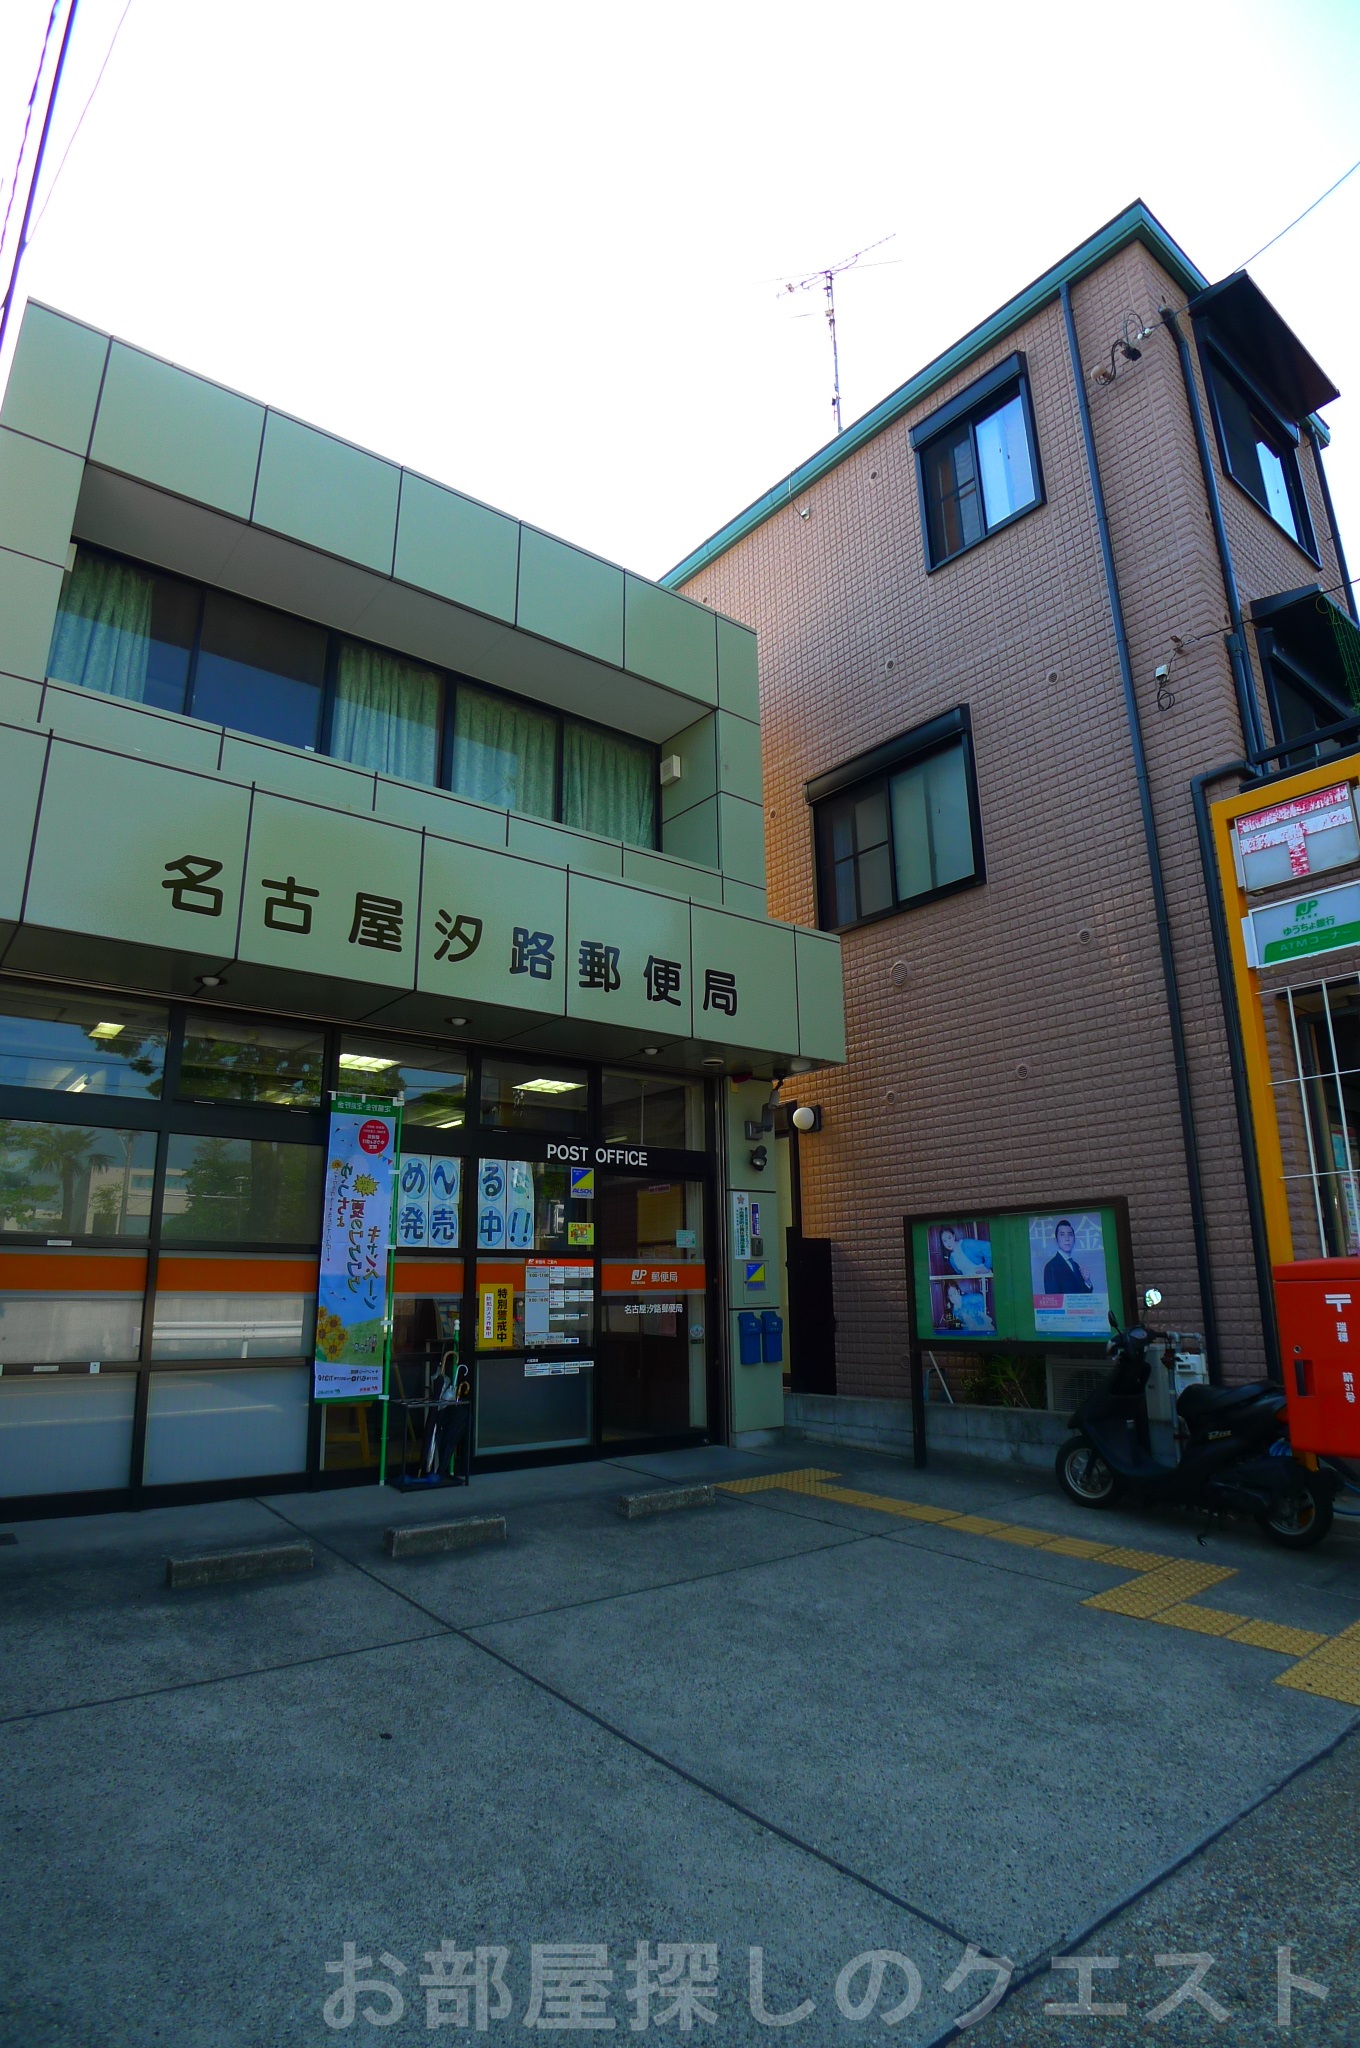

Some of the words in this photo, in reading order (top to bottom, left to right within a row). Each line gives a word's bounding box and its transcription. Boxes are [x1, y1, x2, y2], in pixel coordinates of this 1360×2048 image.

[1295, 900, 1318, 917] JP
[162, 854, 738, 1016] 名古屋汐路郵便局
[1283, 916, 1336, 937] ゆうちょ銀行
[547, 1143, 589, 1162] POST
[595, 1148, 648, 1167] OFFICE
[1029, 1215, 1105, 1250] 年金
[631, 1269, 648, 1281] JP
[651, 1271, 678, 1283] 郵便局
[496, 1288, 508, 1343] 特別警戒中
[624, 1303, 683, 1315] 名古屋汐路郵便局
